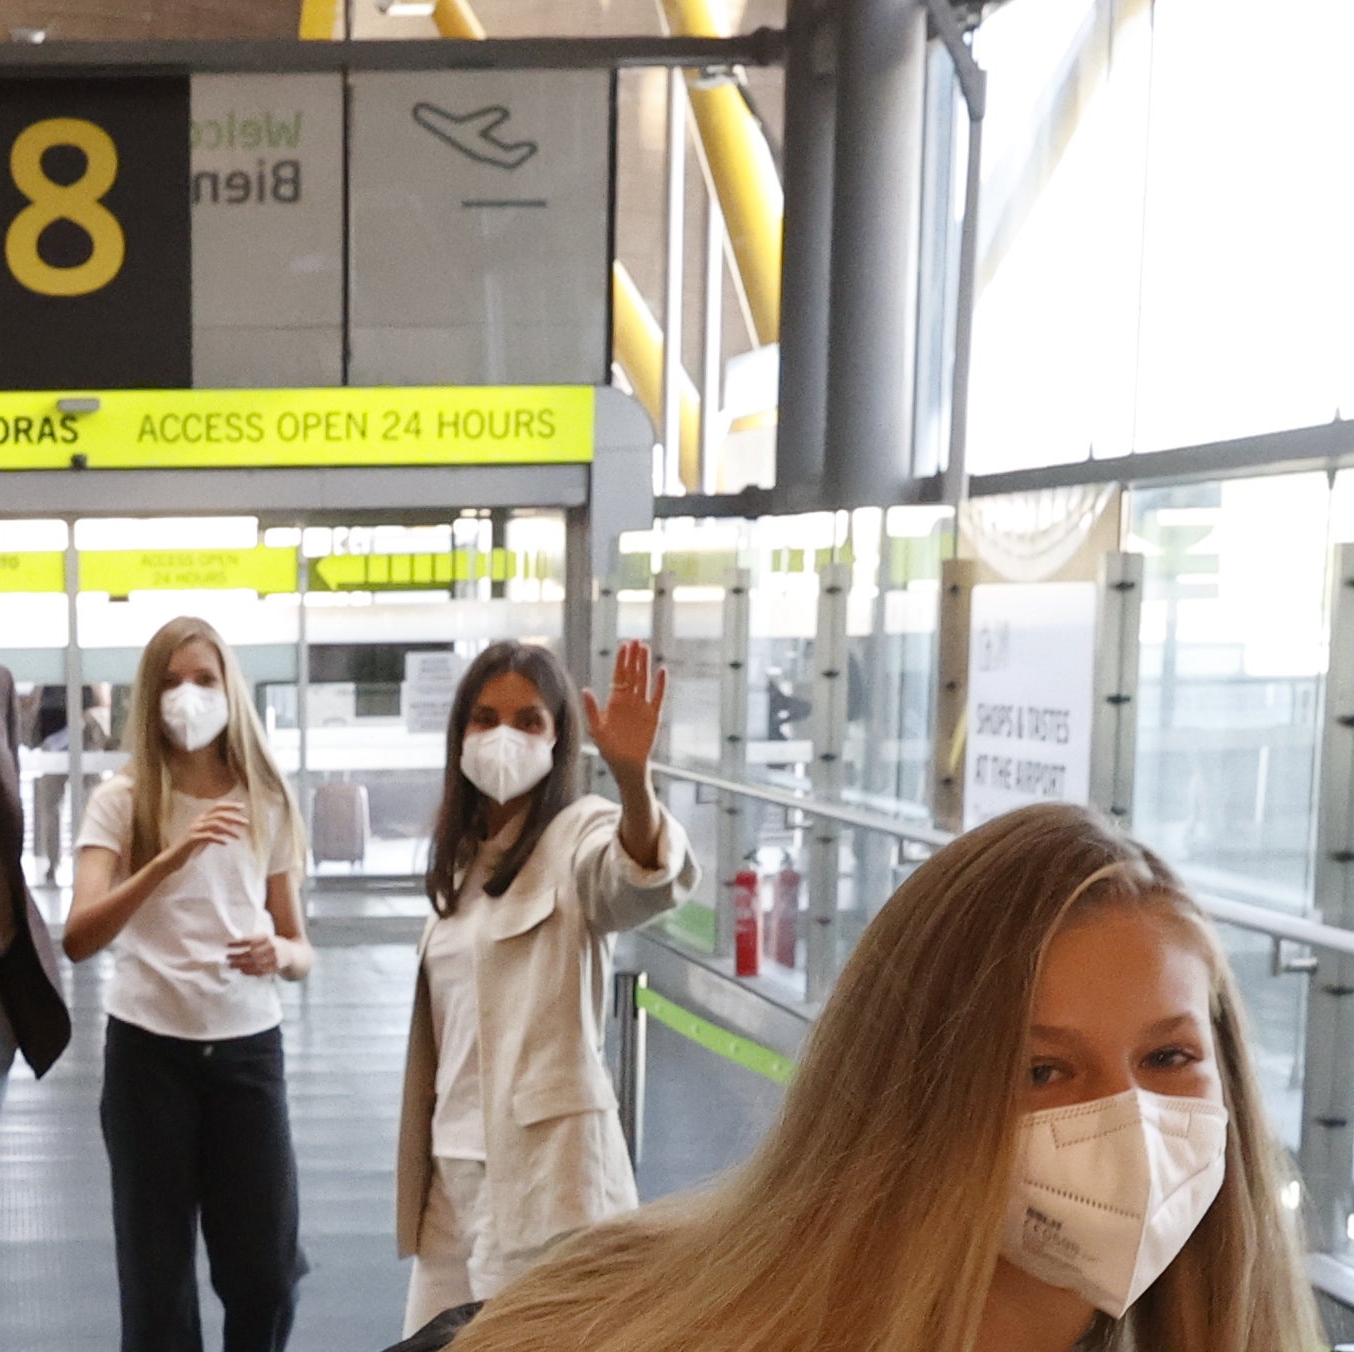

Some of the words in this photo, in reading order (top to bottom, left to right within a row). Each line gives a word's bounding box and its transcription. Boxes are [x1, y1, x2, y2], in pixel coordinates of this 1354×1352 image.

[4, 116, 126, 297] 8
[137, 412, 265, 445] ACCESS
[276, 410, 370, 443] OPEN
[381, 409, 423, 441] 24
[435, 407, 556, 441] HOURS
